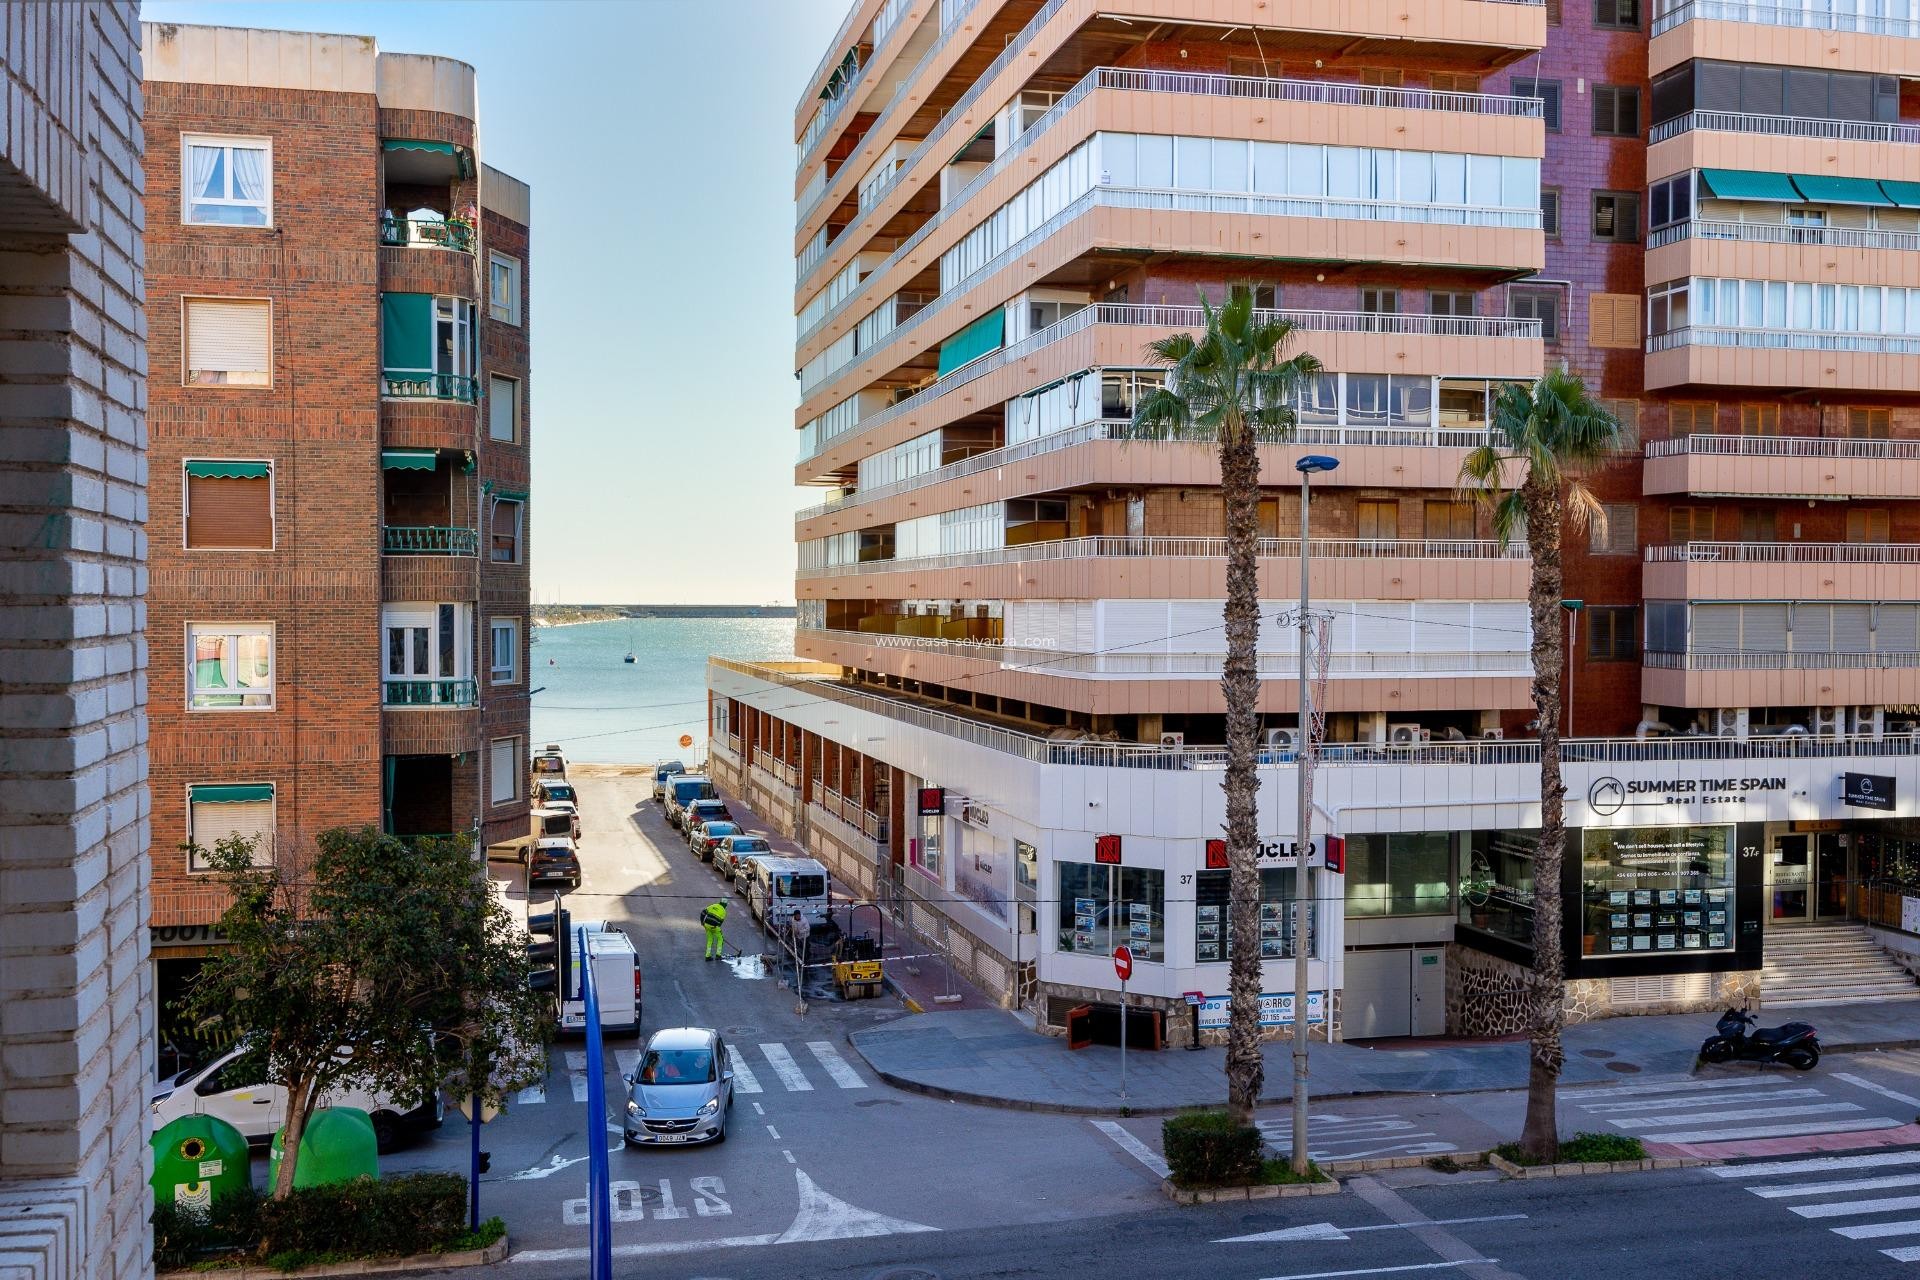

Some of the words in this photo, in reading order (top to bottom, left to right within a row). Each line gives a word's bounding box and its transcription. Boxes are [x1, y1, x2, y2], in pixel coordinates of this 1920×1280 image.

[1627, 780, 1696, 794] SUMMER
[1699, 778, 1737, 792] TIME
[1740, 777, 1786, 791] SPAIN
[1666, 796, 1696, 805] Real
[1702, 795, 1746, 804] Estate
[1256, 840, 1316, 858] ÚCLEO
[1180, 875, 1193, 885] 37
